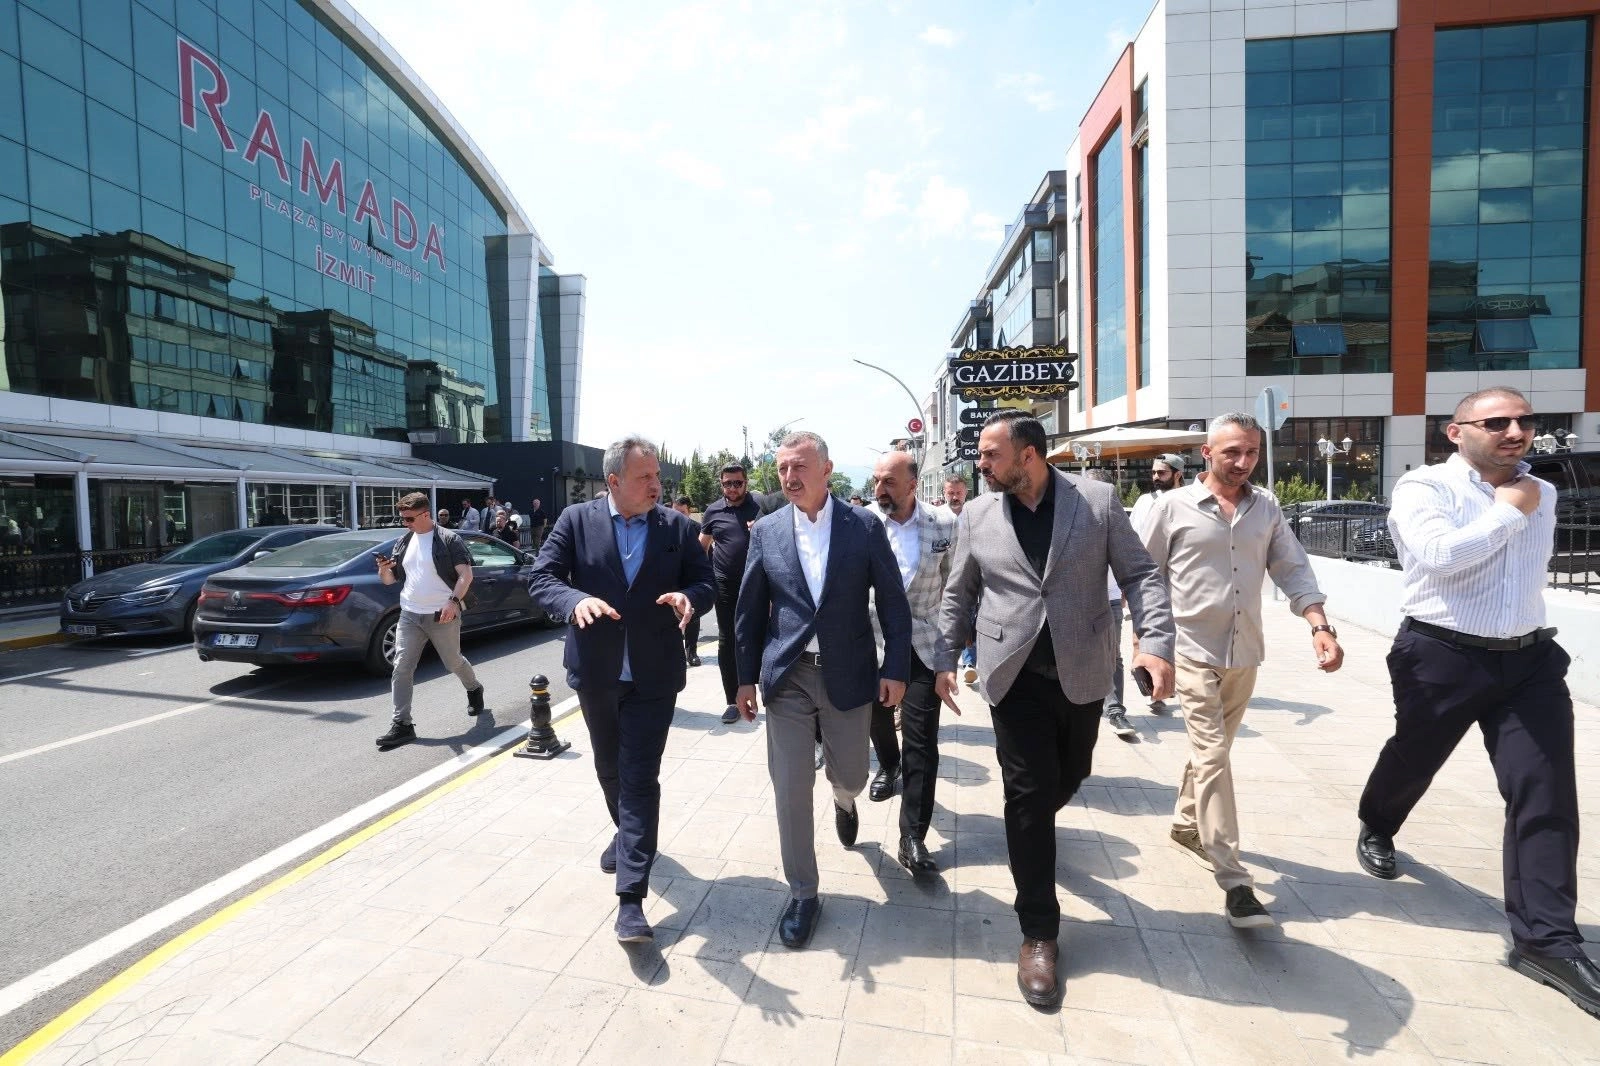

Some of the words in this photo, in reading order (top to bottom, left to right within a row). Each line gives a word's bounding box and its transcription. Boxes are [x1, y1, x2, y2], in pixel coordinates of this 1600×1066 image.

[177, 36, 446, 271] RAMADA
[250, 183, 318, 232] PLAZA
[324, 222, 345, 243] BY
[350, 236, 421, 284] WYNDHAM
[316, 245, 376, 294] İZMİT
[956, 361, 1069, 383] GAZİBEY
